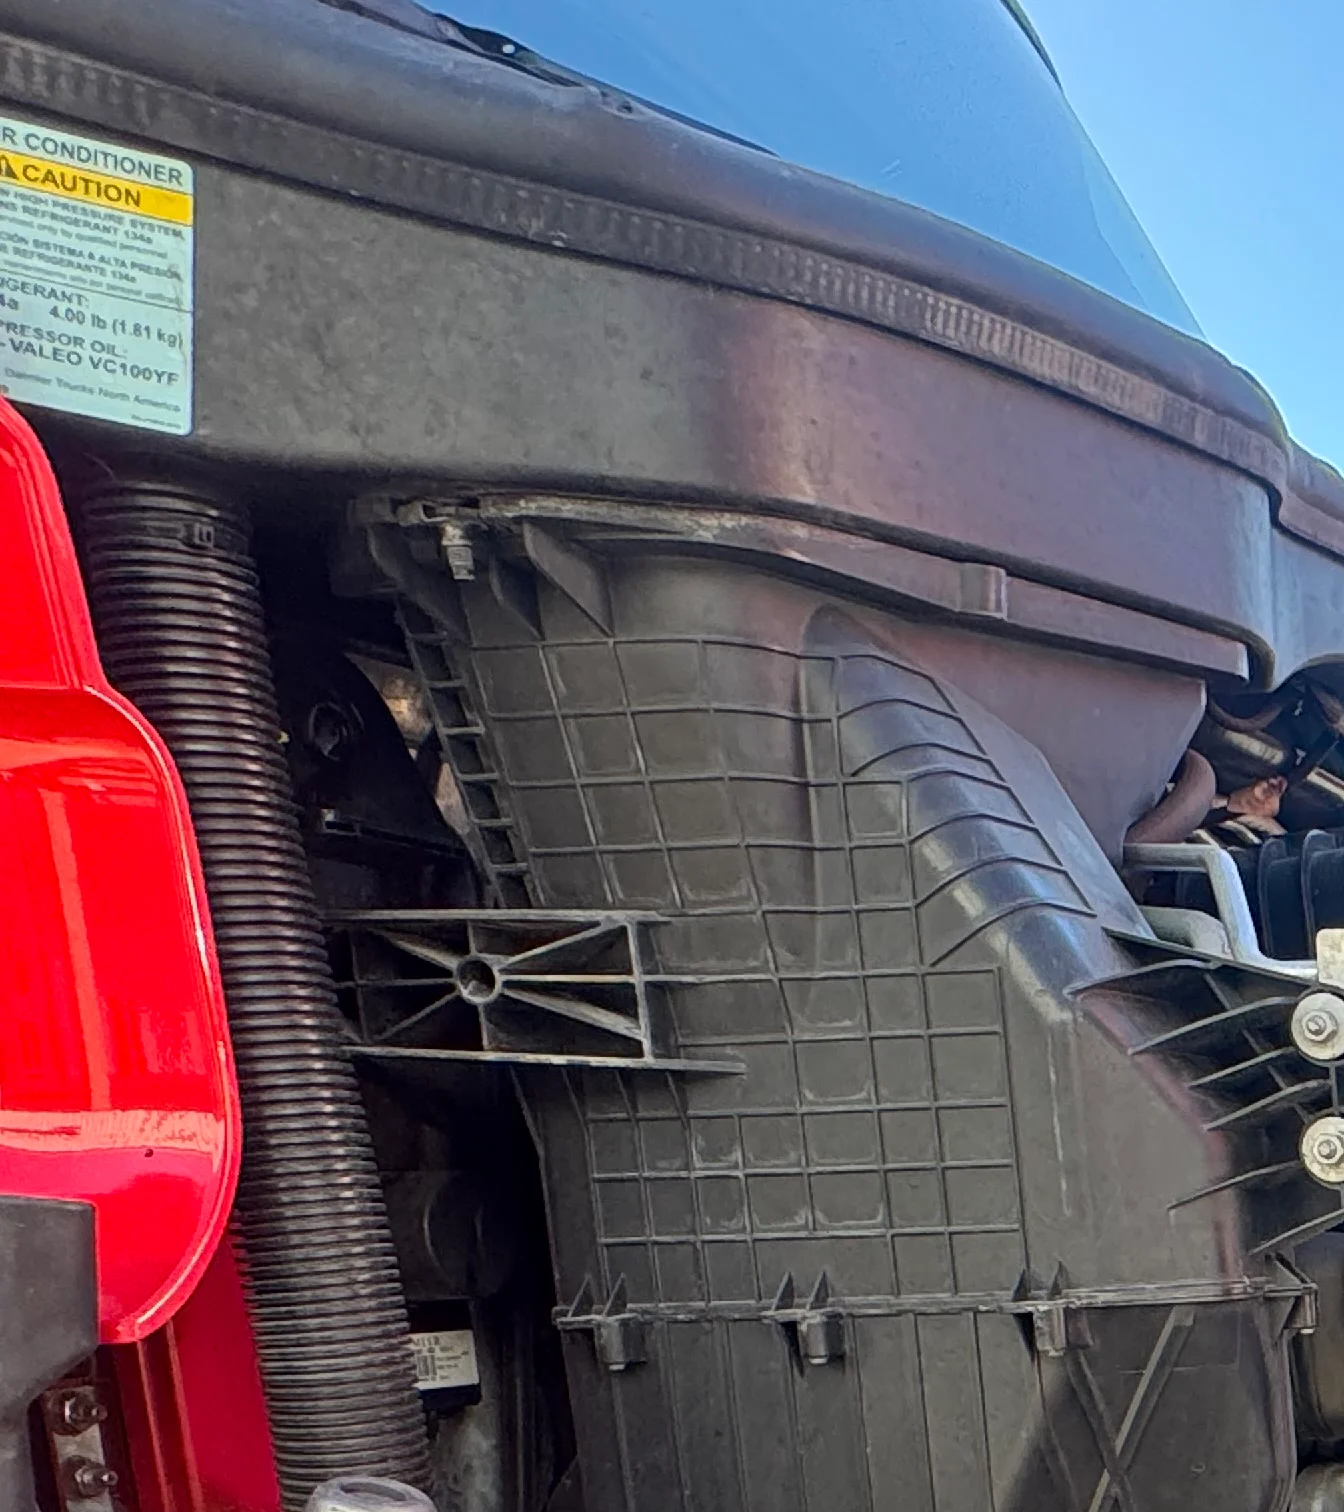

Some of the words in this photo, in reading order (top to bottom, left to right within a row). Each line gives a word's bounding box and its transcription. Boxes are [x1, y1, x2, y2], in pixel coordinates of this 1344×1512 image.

[24, 132, 183, 187] CONDITIONER
[22, 164, 141, 208] CAUTION
[22, 204, 118, 236] REFRIGERANT
[49, 305, 86, 326] 4.00
[90, 312, 107, 330] lb
[156, 327, 184, 350] kg)
[9, 337, 82, 366] VALEO
[88, 354, 180, 386] VC100YF
